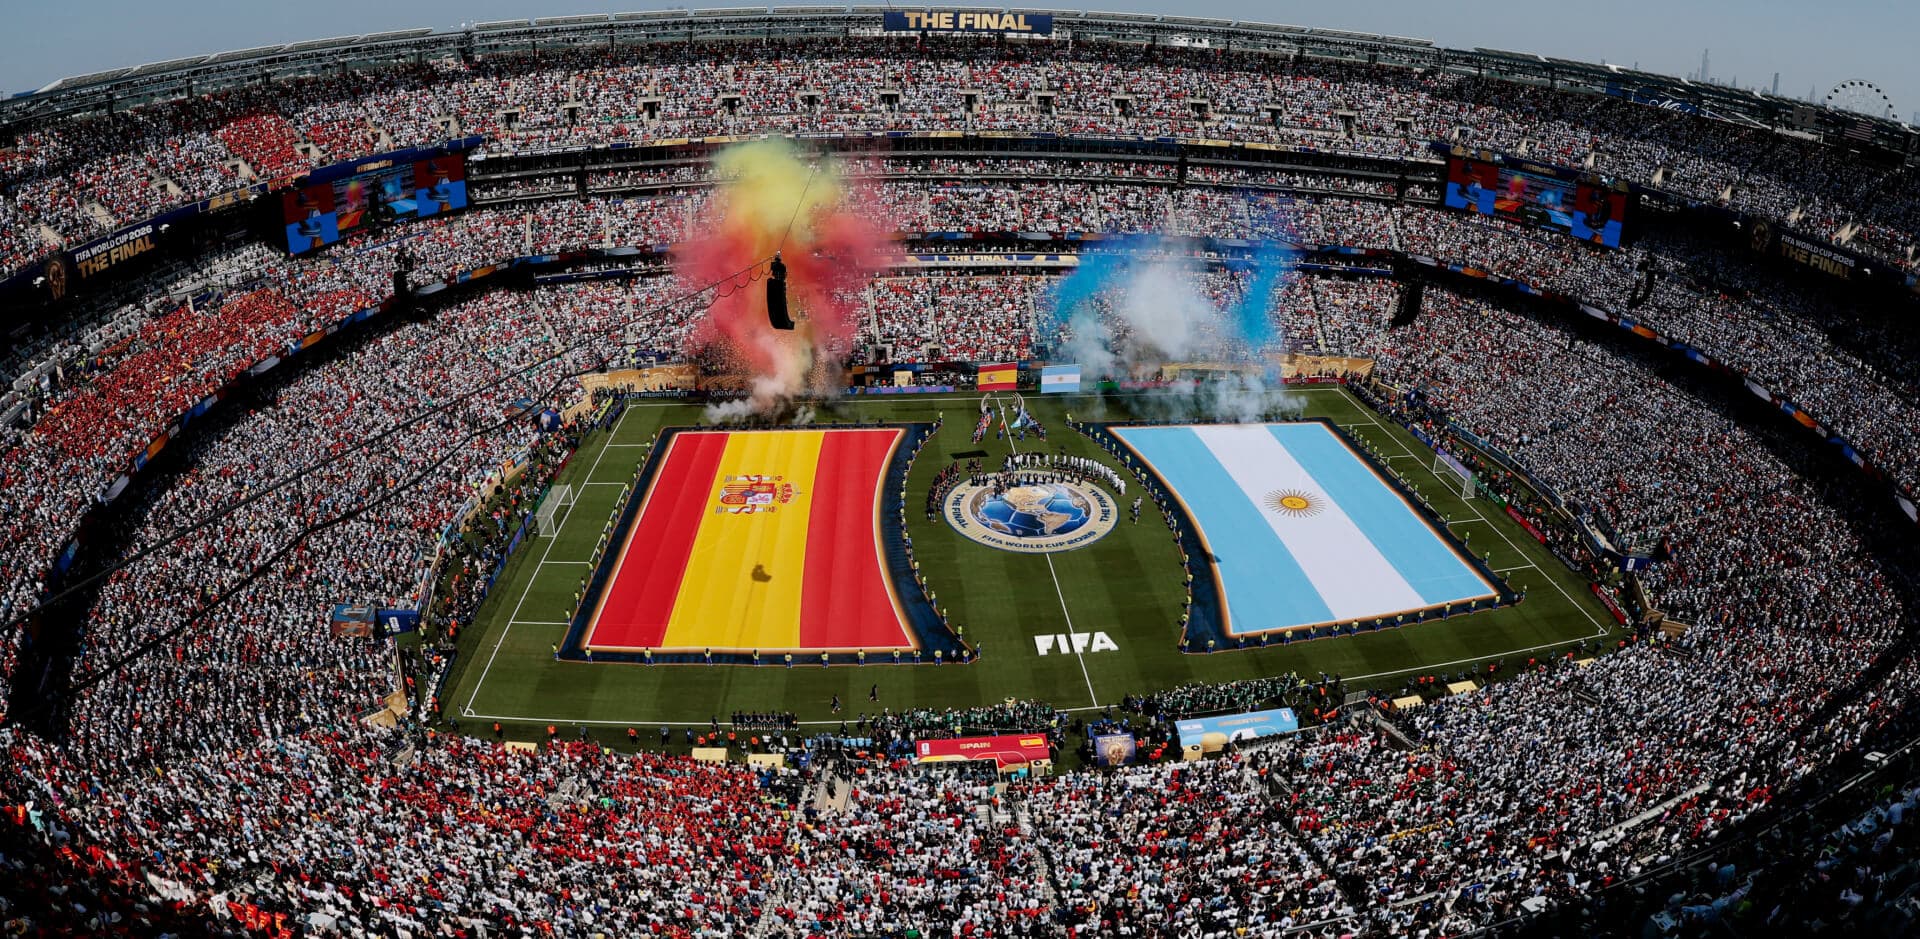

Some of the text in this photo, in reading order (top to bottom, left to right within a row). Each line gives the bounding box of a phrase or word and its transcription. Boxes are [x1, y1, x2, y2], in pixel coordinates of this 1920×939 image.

[904, 12, 1032, 31] THE FINAL
[75, 225, 153, 263] FIFA WORLD CUP 2026
[77, 235, 155, 279] THE FINAL
[1781, 234, 1855, 267] FIFA WORLD CUP 2026
[1781, 243, 1809, 265] THE
[951, 493, 969, 529] THE FINAL
[1089, 488, 1111, 522] THE FINAL
[982, 531, 1097, 549] FIFA WORLD CUP 2026
[1034, 631, 1120, 656] FIFA
[959, 742, 991, 750] SPAIN
